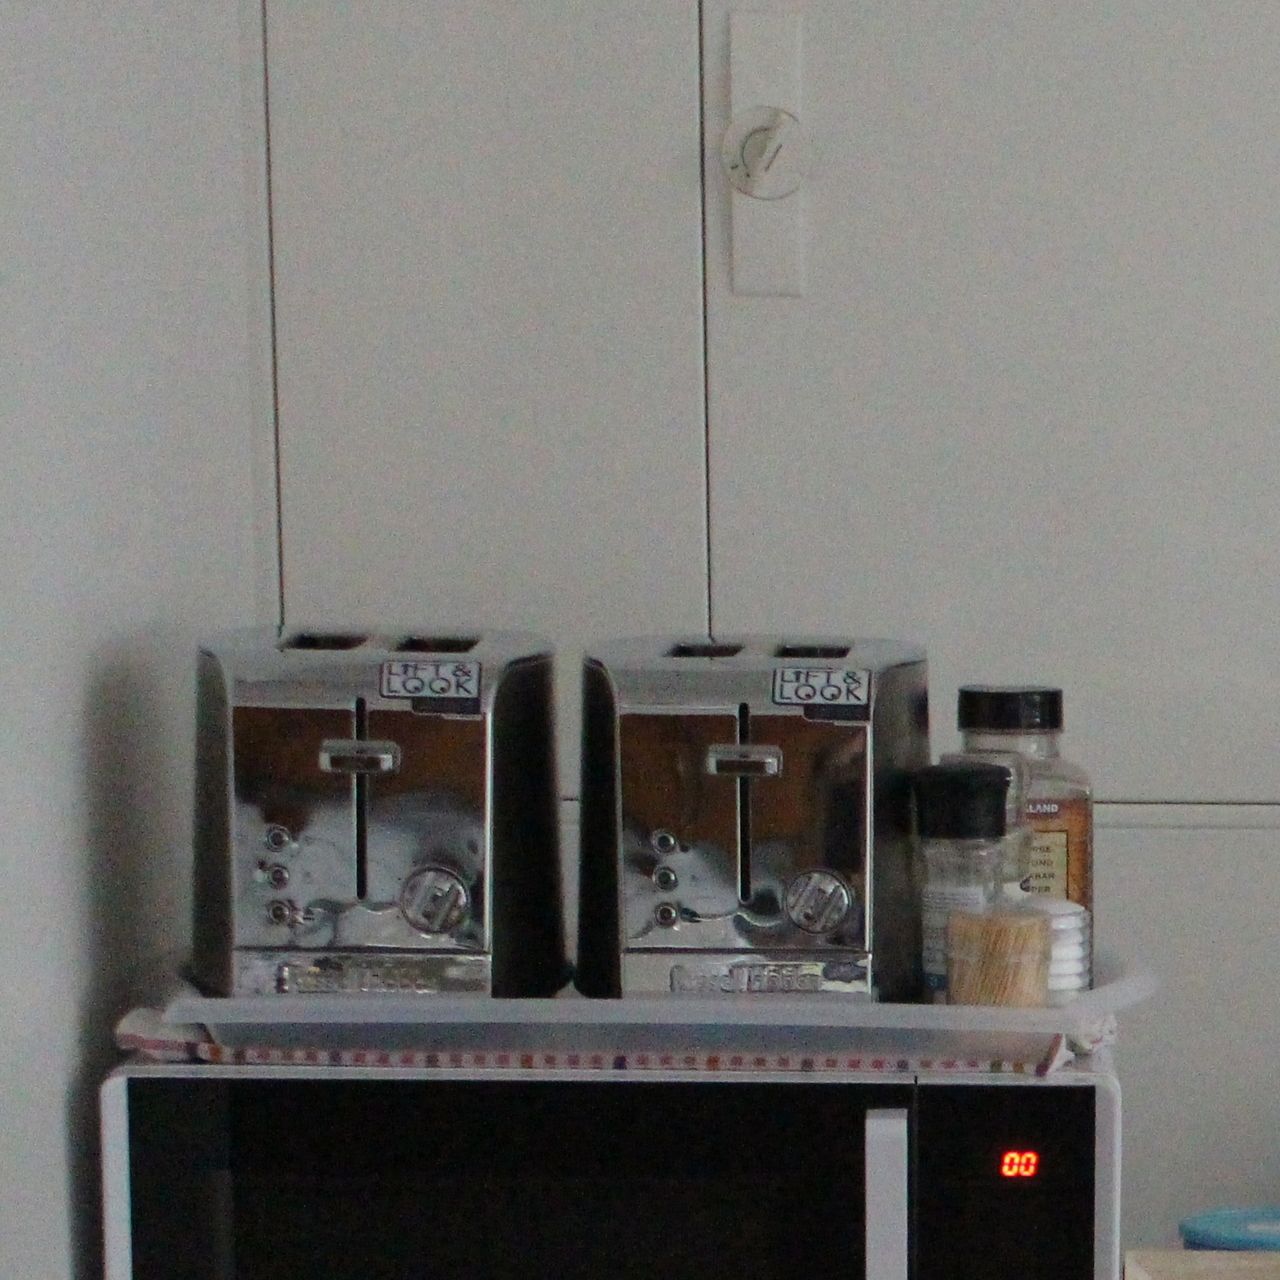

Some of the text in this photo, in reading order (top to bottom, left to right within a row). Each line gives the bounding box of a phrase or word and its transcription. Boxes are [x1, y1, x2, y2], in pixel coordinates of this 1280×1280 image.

[388, 664, 440, 680] LIFT
[781, 670, 861, 684] LIFT &
[387, 678, 473, 694] LOOK
[780, 684, 862, 701] LOOK
[1002, 1151, 1038, 1177] 00
